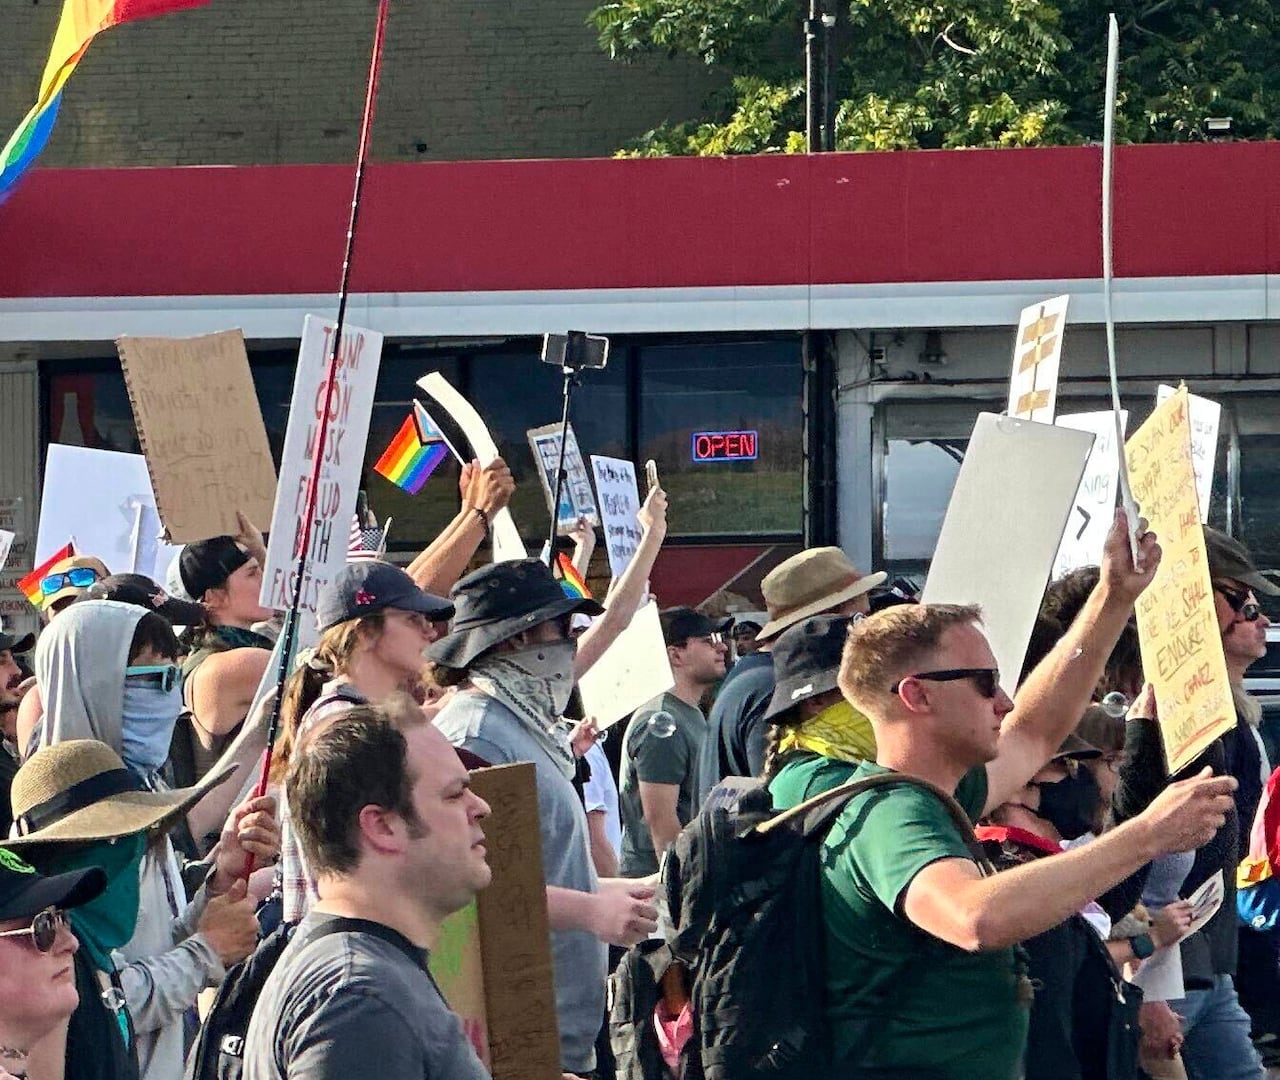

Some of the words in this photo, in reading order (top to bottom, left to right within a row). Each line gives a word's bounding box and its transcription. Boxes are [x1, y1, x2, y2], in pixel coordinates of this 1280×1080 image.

[323, 327, 365, 369] TUMP
[304, 424, 344, 466] MSK
[696, 434, 755, 459] OPEN
[295, 475, 341, 520] FUD
[291, 516, 333, 564] BTH
